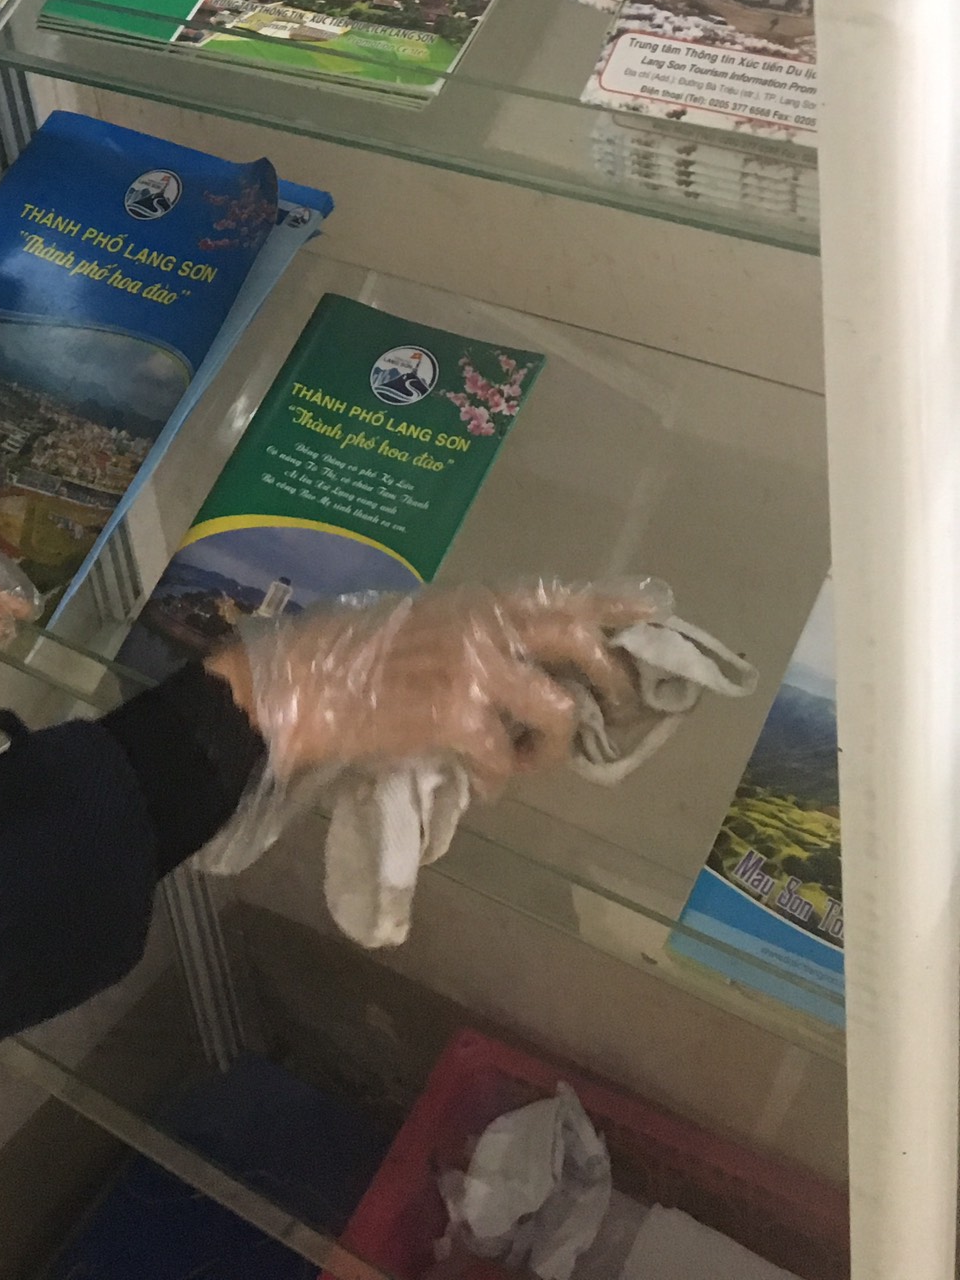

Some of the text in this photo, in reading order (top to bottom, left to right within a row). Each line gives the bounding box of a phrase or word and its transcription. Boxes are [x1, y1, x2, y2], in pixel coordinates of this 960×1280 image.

[666, 59, 686, 71] Son
[689, 63, 728, 80] Tourism
[775, 875, 814, 923] Son
